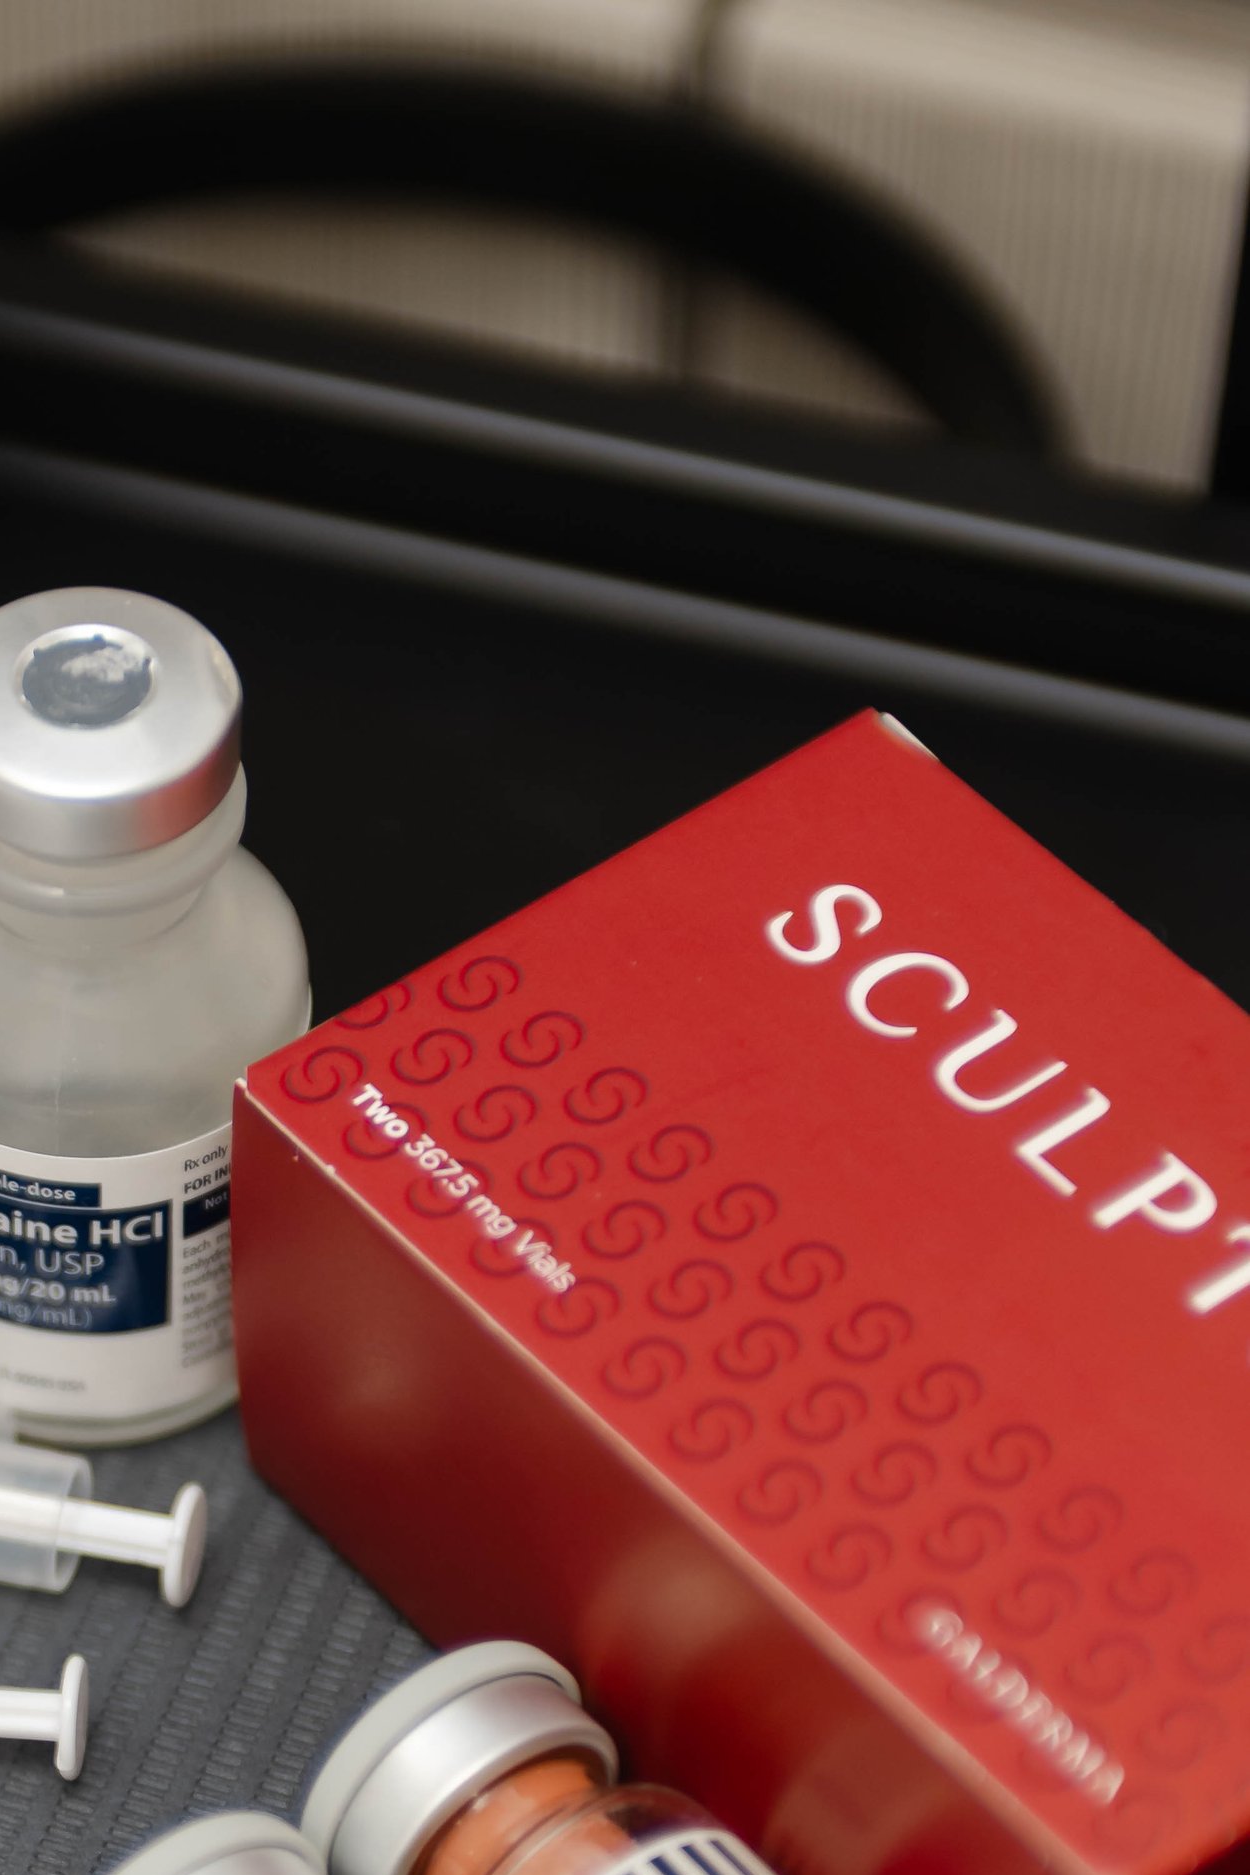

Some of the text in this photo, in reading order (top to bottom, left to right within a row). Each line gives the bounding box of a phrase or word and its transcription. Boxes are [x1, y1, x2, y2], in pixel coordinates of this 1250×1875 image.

[184, 1143, 229, 1173] Rx only
[183, 1161, 231, 1195] FOR IN
[352, 1082, 578, 1294] Two 367.5 mg Vials
[88, 1208, 165, 1247] HCl
[37, 1247, 106, 1278] USP
[71, 1283, 117, 1304] mL
